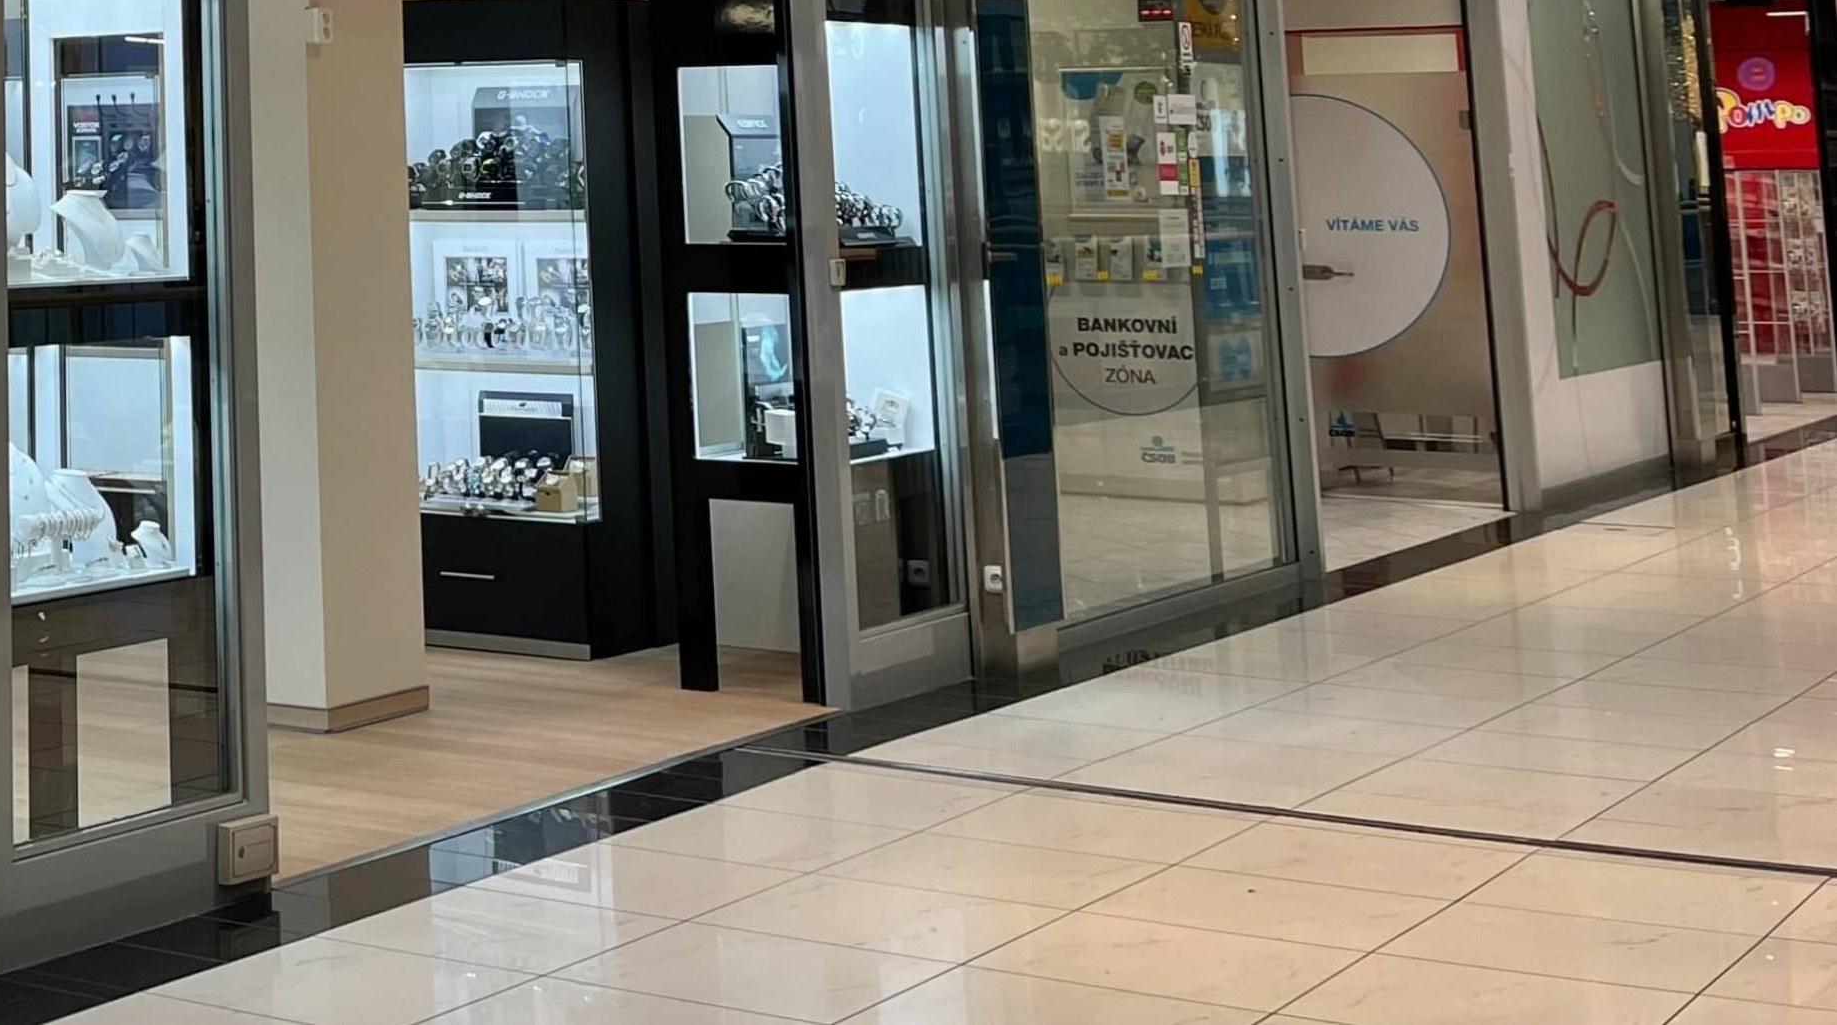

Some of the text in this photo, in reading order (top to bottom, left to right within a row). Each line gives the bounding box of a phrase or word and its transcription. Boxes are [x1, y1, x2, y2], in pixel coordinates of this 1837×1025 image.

[1326, 217, 1420, 232] VÍTÁME VÁS
[1077, 316, 1178, 335] BANKOVNÍ
[1059, 345, 1068, 357] a
[1105, 365, 1156, 385] ZÓNA
